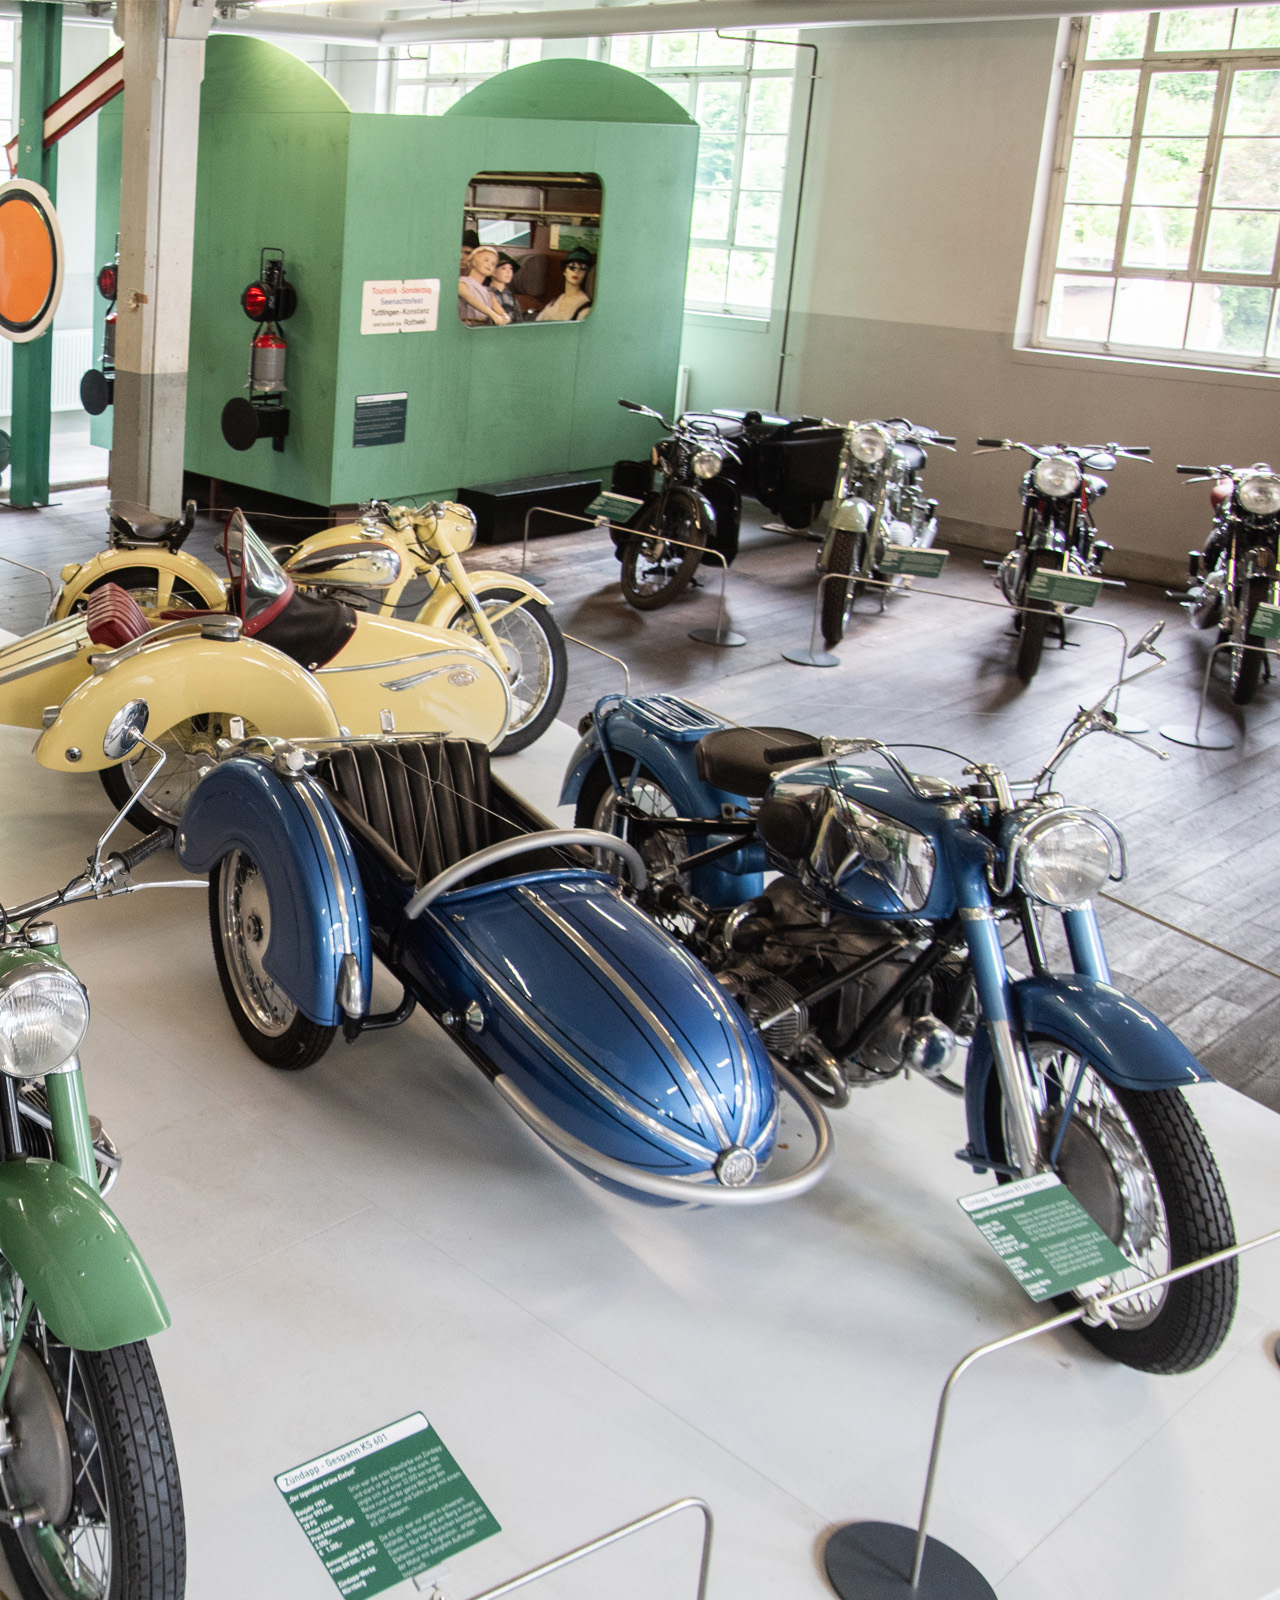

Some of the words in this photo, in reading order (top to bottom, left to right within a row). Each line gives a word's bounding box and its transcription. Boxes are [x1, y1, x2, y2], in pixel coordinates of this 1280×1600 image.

[284, 1466, 320, 1486] Zündapp
[325, 1447, 360, 1466] Gespann
[360, 1441, 373, 1450] KS
[373, 1433, 387, 1445] 601
